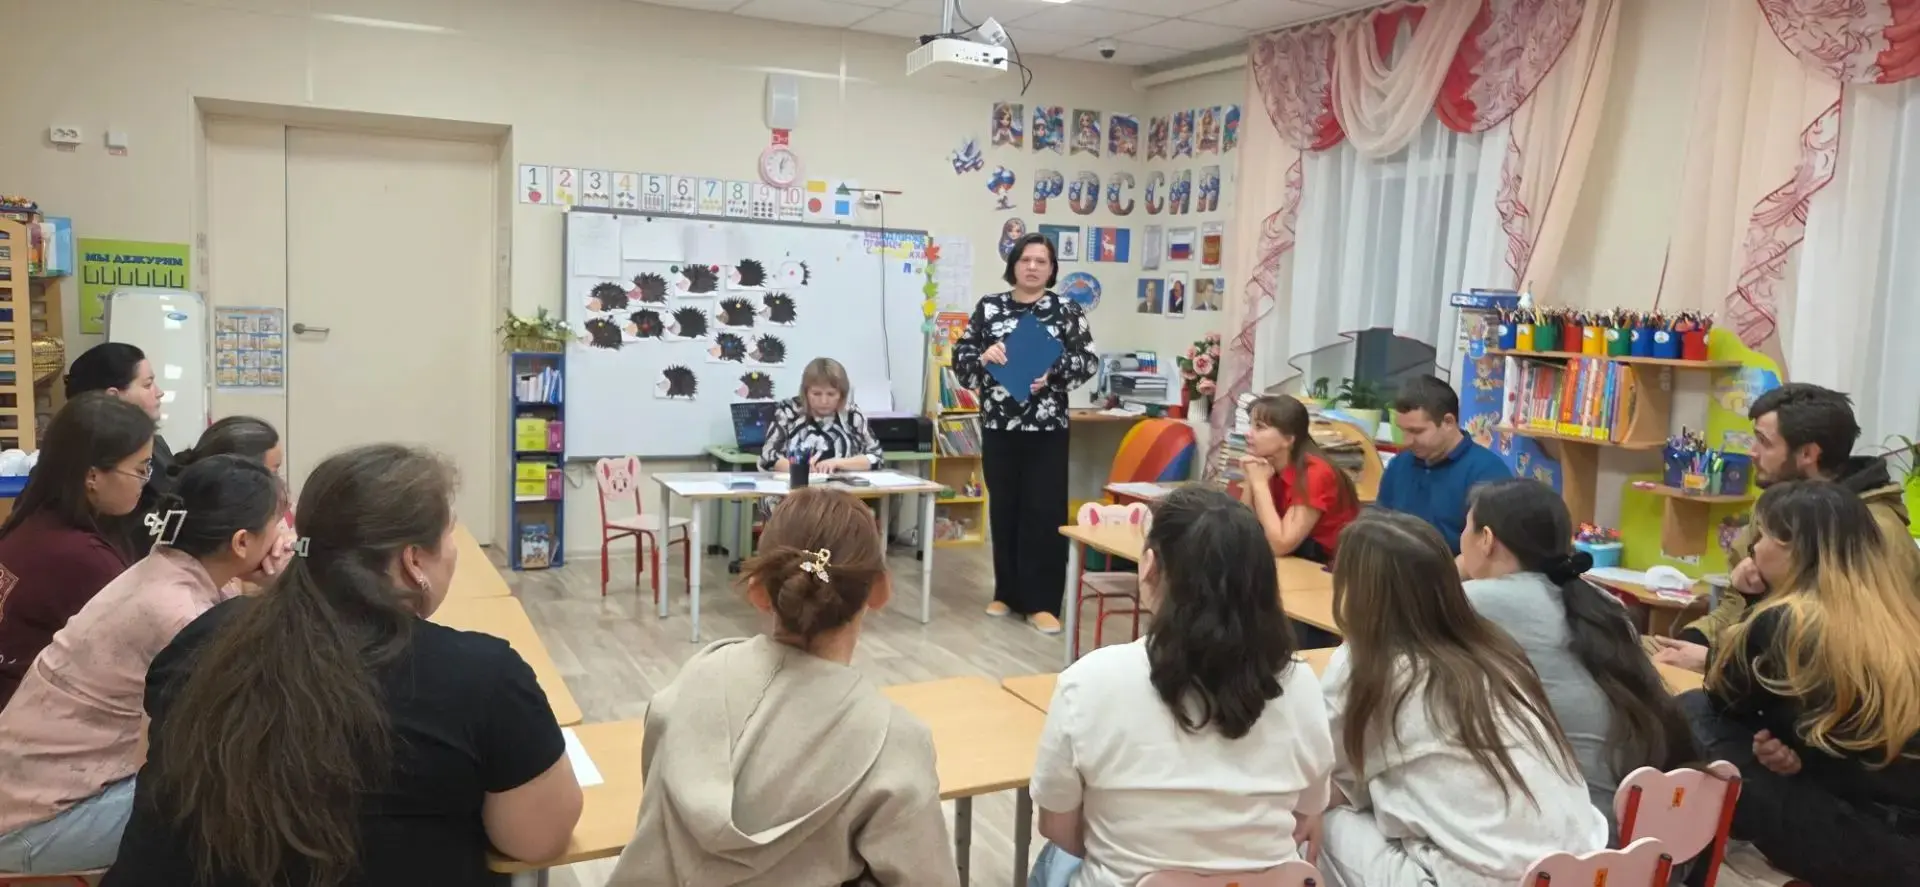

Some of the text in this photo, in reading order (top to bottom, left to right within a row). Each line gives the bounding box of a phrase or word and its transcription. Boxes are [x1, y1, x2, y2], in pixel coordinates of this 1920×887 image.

[528, 167, 800, 205] 1 2 3 4 5 6 7 8 9 10
[1033, 165, 1220, 216] РОССИЯ
[85, 253, 184, 266] МЫ ДЕЖУРИМ
